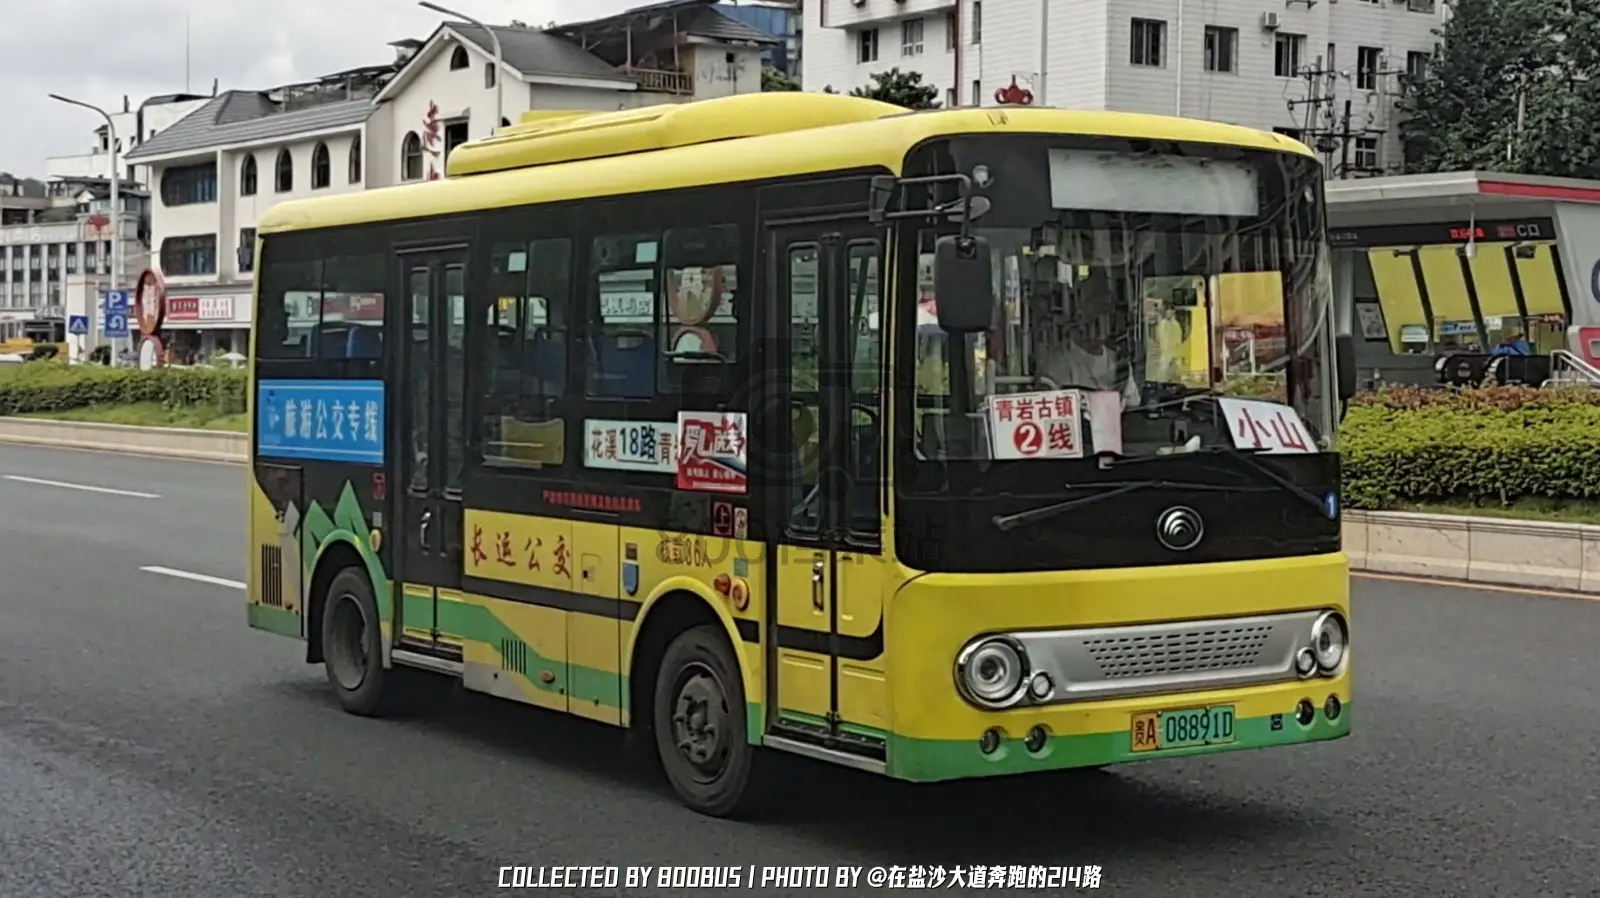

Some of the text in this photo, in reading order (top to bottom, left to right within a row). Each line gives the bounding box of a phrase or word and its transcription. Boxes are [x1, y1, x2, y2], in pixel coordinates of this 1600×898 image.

[108, 291, 122, 309] P
[994, 395, 1074, 422] 青岩古镇
[1238, 407, 1309, 452] 小山
[1166, 711, 1233, 743] 08891D
